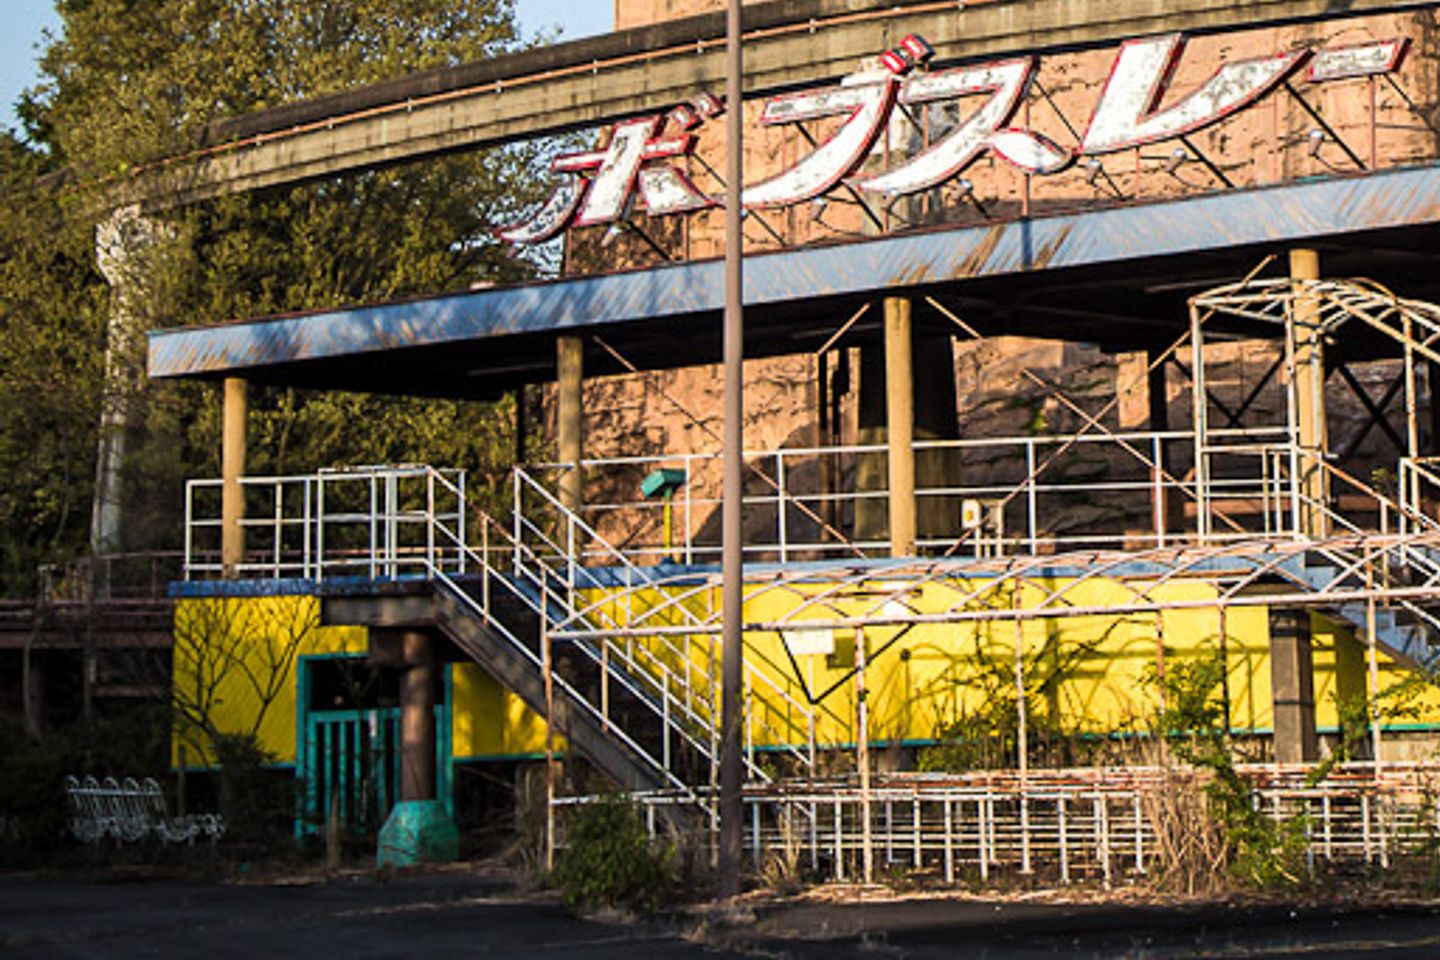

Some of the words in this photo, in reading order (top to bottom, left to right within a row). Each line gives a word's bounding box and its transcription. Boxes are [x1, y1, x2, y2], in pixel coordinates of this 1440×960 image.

[493, 32, 1411, 244] ボブスレー
